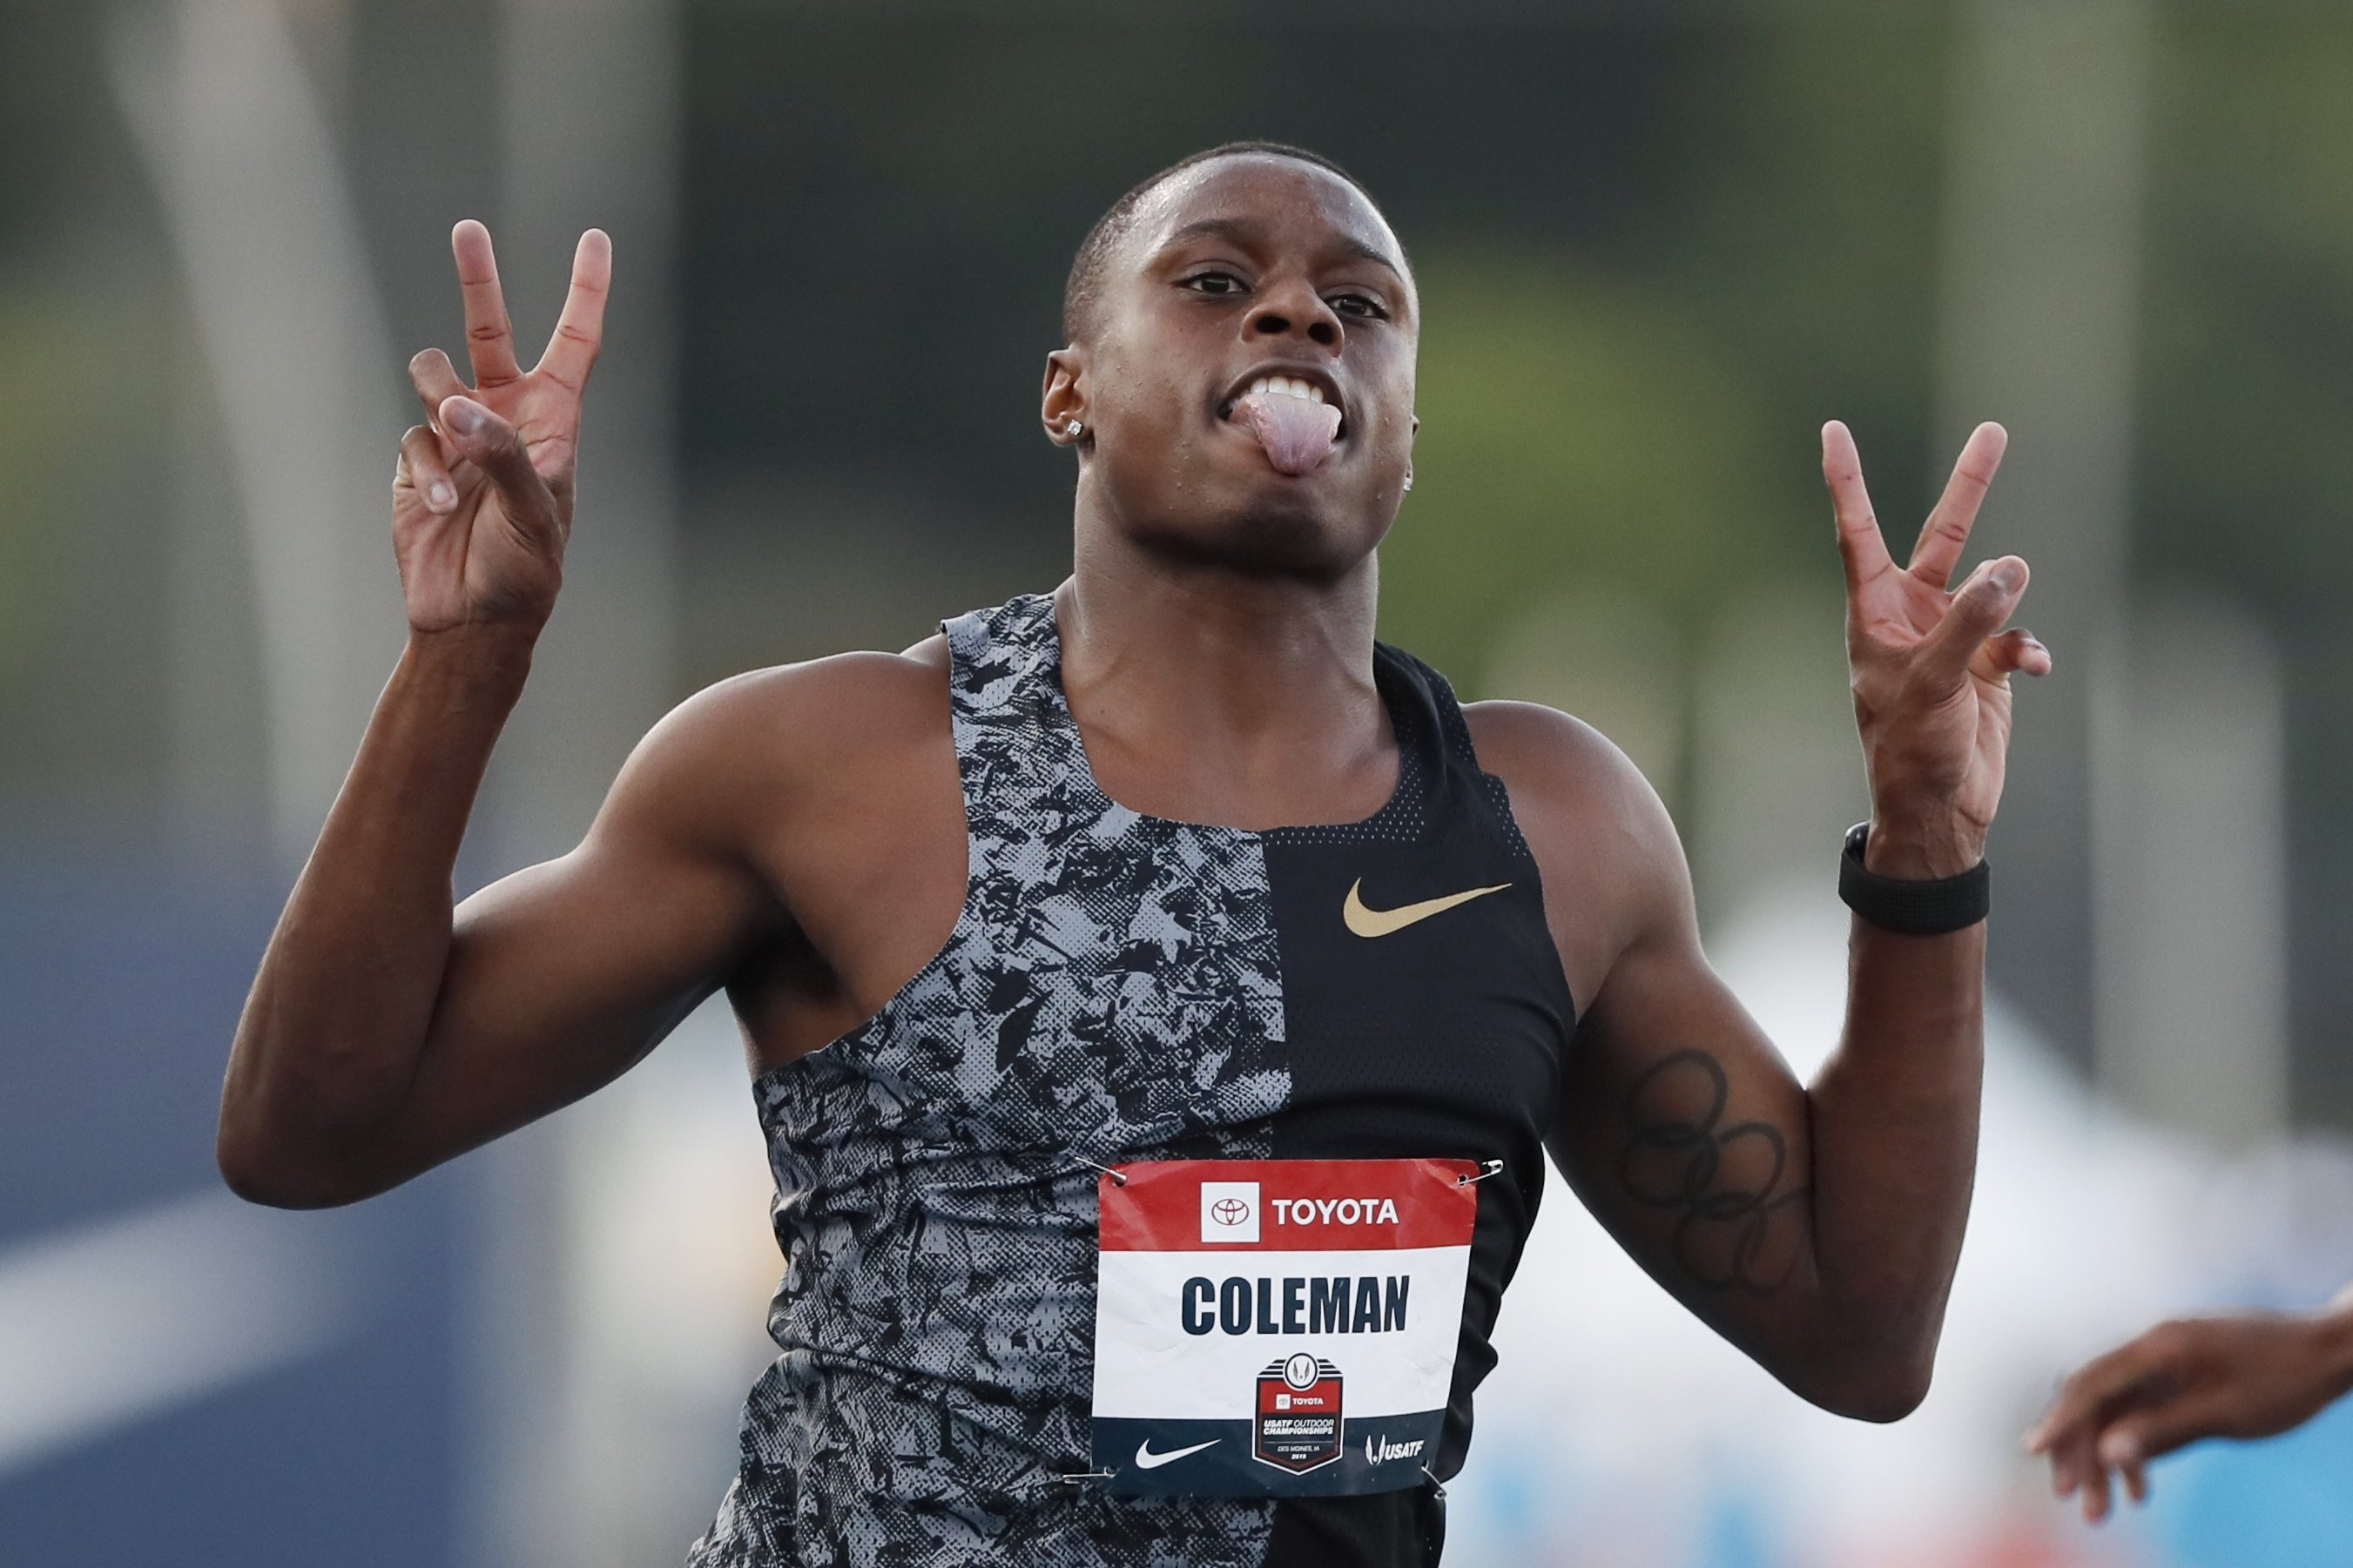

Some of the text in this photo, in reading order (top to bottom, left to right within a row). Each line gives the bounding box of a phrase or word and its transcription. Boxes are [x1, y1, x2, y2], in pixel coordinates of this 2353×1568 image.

[1271, 1198, 1399, 1225] TOYOTA
[1181, 1275, 1411, 1336] COLEMAN
[1264, 1419, 1293, 1428] USATF
[1385, 1440, 1425, 1461] USATF
